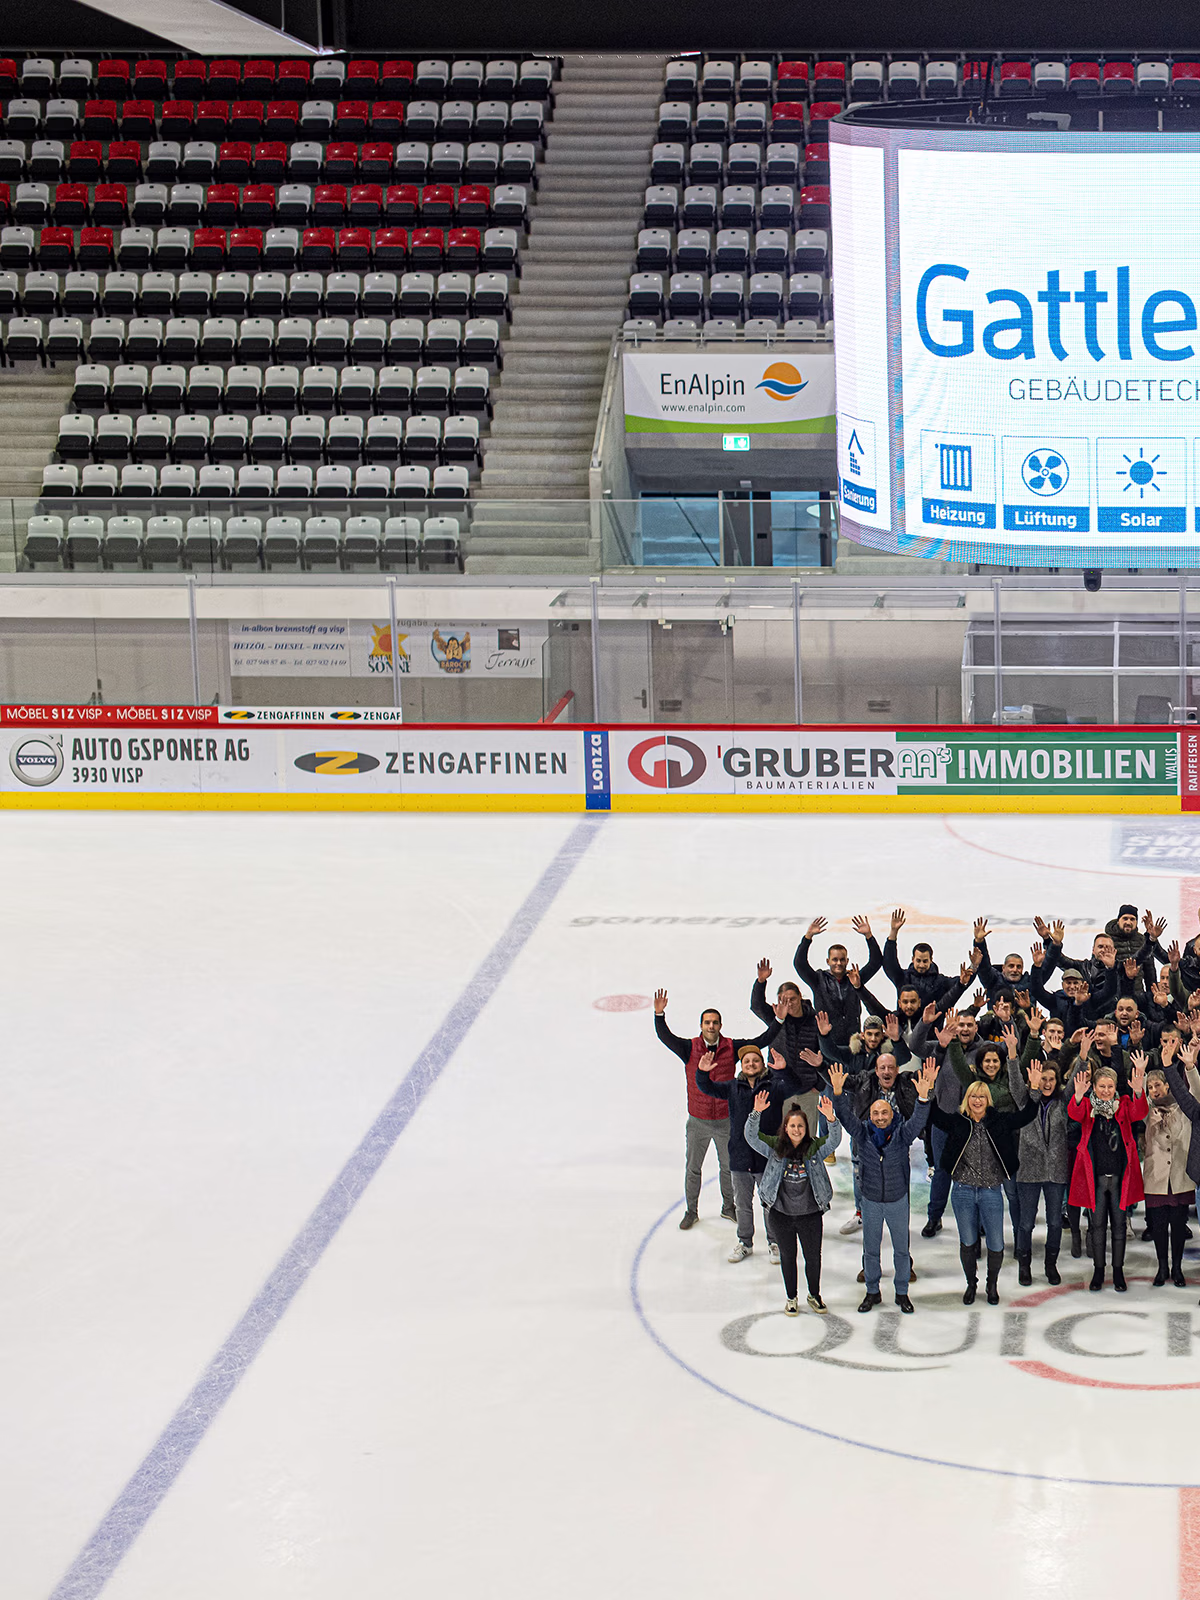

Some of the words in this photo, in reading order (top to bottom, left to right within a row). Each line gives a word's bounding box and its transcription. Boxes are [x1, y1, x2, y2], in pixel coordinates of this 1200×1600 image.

[660, 373, 745, 400] EnAlpin
[661, 402, 746, 414] www.enalpin.com
[843, 485, 876, 511] Sanierung
[930, 503, 986, 525] Heizung
[1014, 509, 1077, 528] Lüftung
[1120, 512, 1163, 527] Solar
[241, 624, 273, 632] in-albon
[274, 624, 316, 634] brennstoff
[329, 625, 345, 633] visp
[233, 642, 266, 650] HEIZÖL
[7, 706, 48, 719] MÖBEL
[77, 708, 103, 719] VISP
[116, 706, 158, 720] MÖBEL
[186, 708, 212, 720] VISP
[257, 711, 325, 720] ZENGAFFINEN
[72, 738, 122, 761] AUTO
[128, 738, 218, 761] GSPONER
[224, 738, 250, 761] AG
[385, 752, 567, 775] ZENGAFFINEN
[590, 733, 604, 791] Lonza
[957, 749, 1157, 779] IMMOBILIEN
[1165, 748, 1178, 780] WALLIS
[1187, 734, 1198, 792] RAIFFEISEN
[73, 767, 107, 783] 3930
[112, 767, 143, 783] VISP
[746, 780, 876, 790] BAUMATERIALIEN
